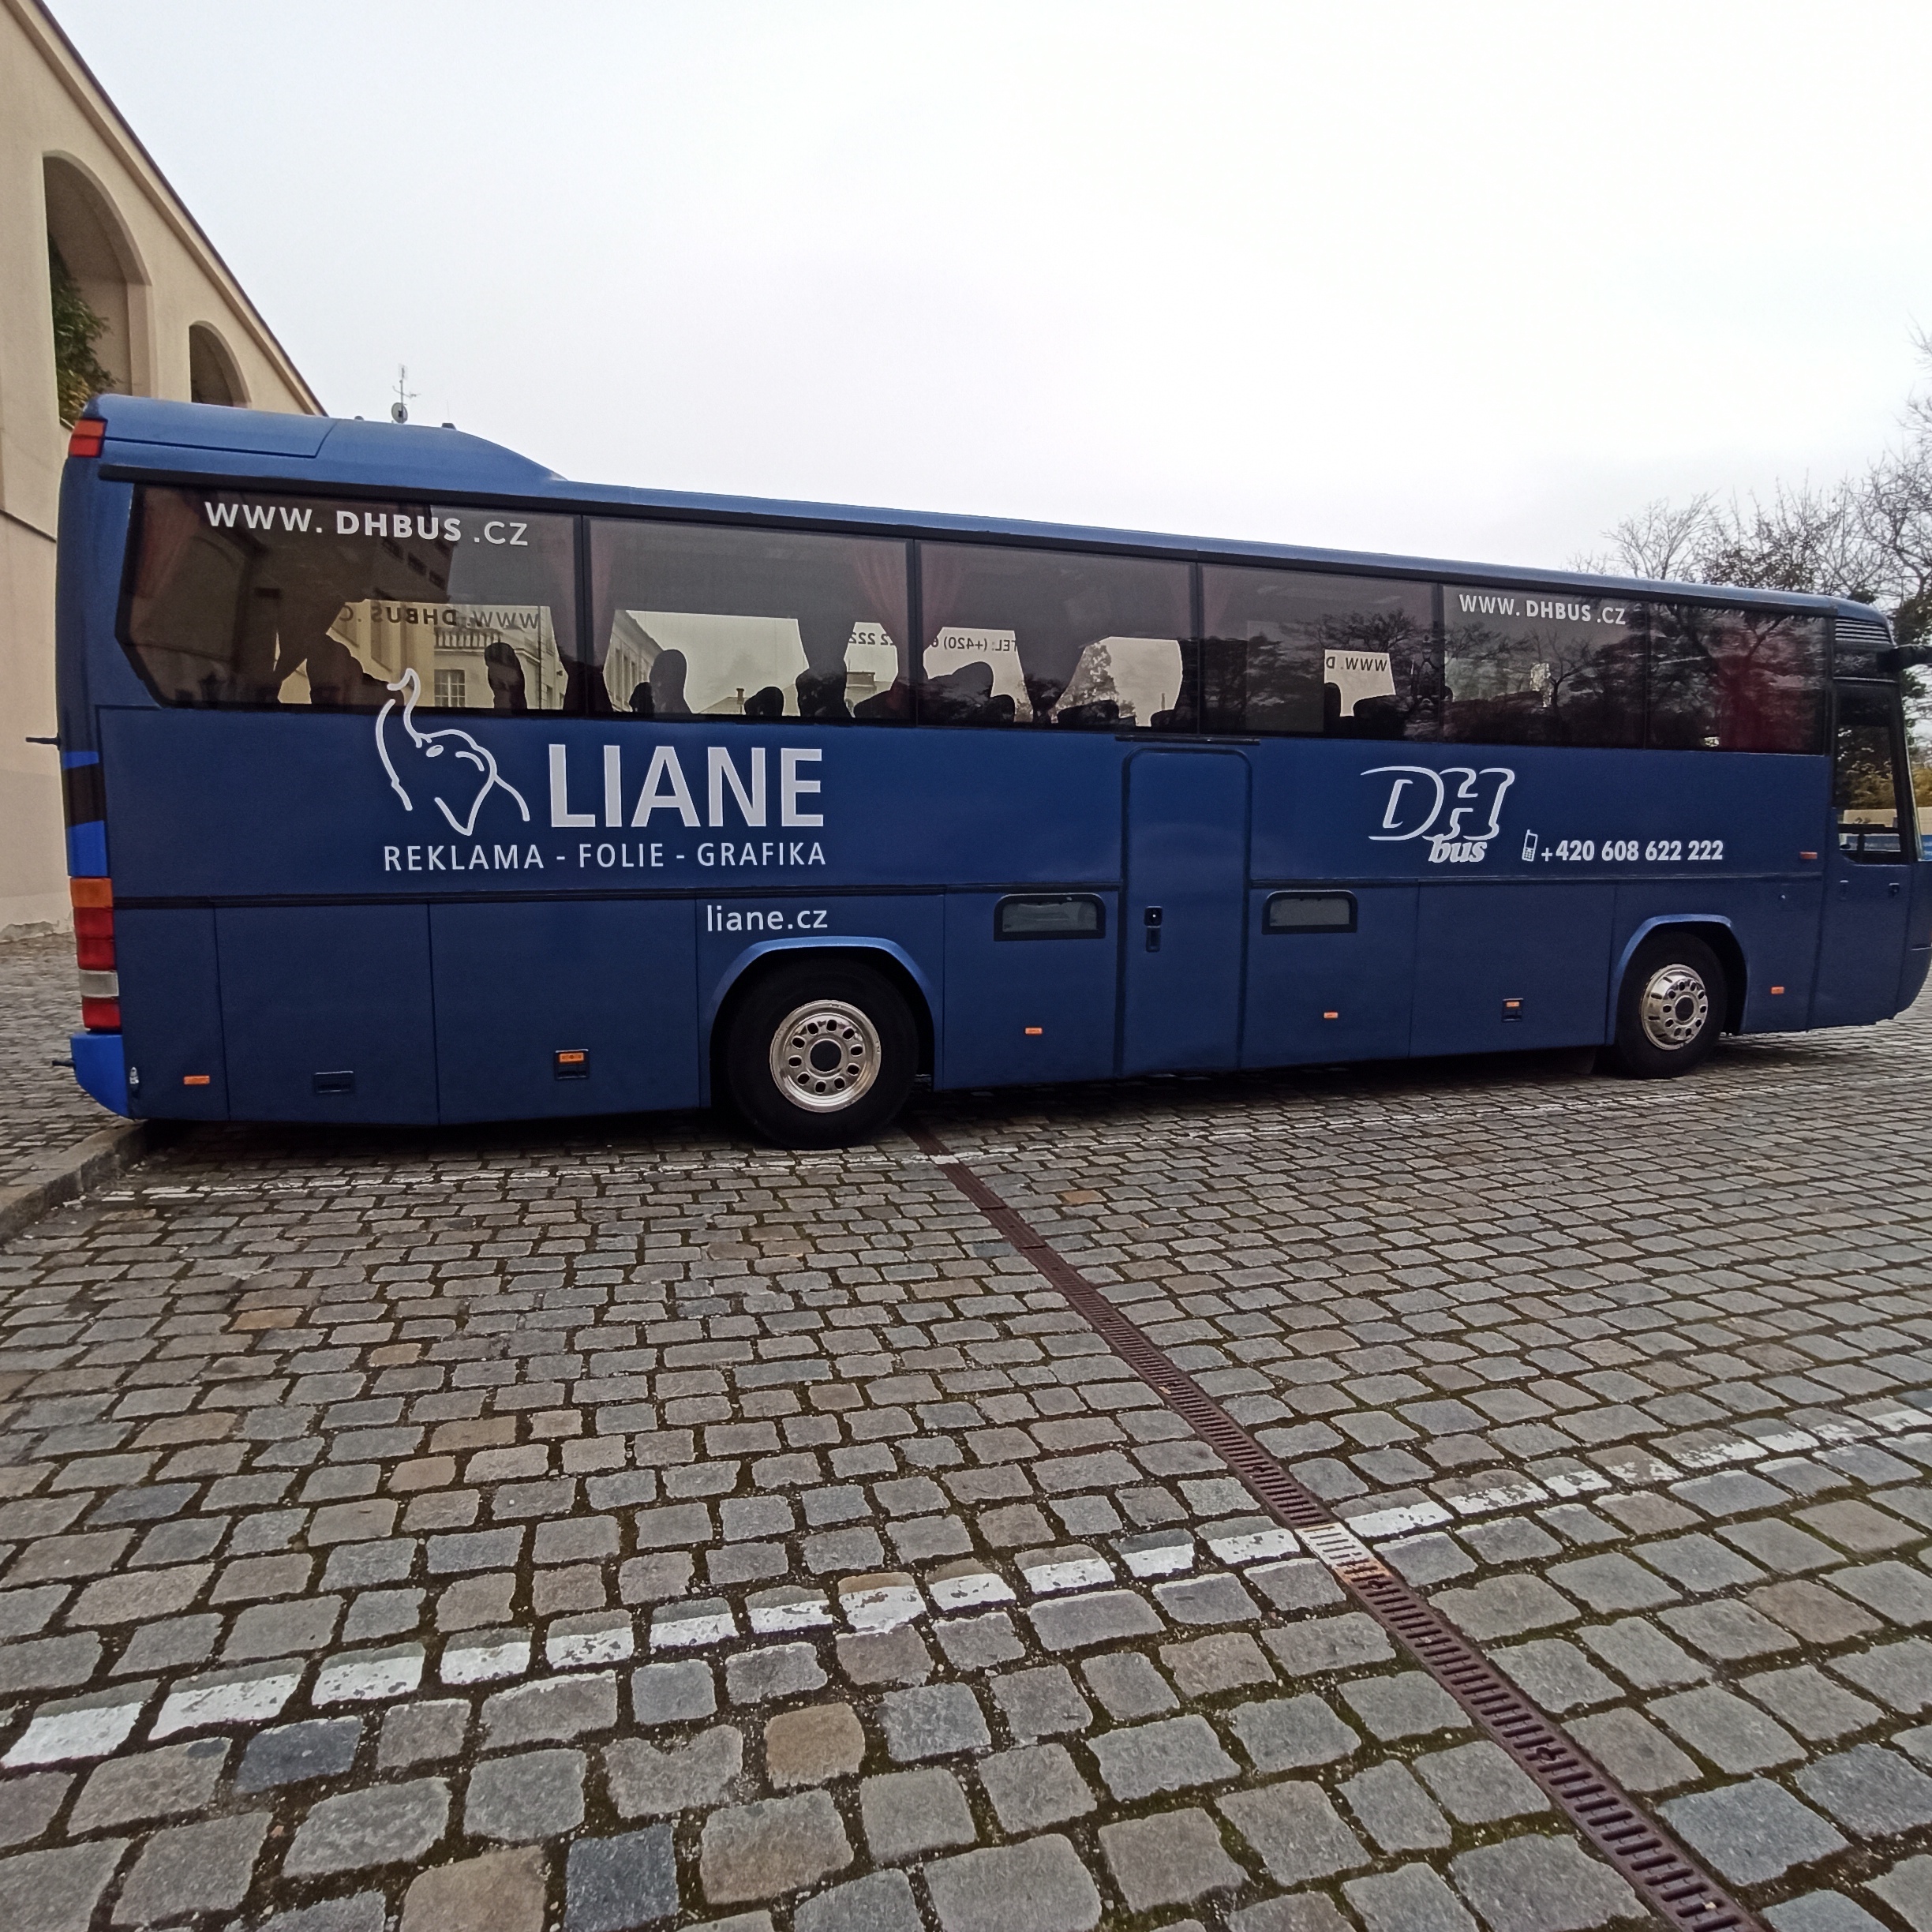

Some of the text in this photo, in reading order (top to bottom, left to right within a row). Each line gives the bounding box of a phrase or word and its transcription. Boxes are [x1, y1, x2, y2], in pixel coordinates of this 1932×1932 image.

[336, 511, 462, 541] DHBUS
[1526, 600, 1591, 622] DHBUS
[549, 743, 824, 828] LIANE
[1360, 766, 1515, 841] DH
[384, 844, 545, 871] REKLAMA
[579, 843, 664, 868] FOLIE
[697, 842, 826, 867] GRAFIKA
[1428, 834, 1488, 863] bus
[1541, 840, 1724, 862] +420 608 622 222
[707, 904, 828, 932] liane.cz
